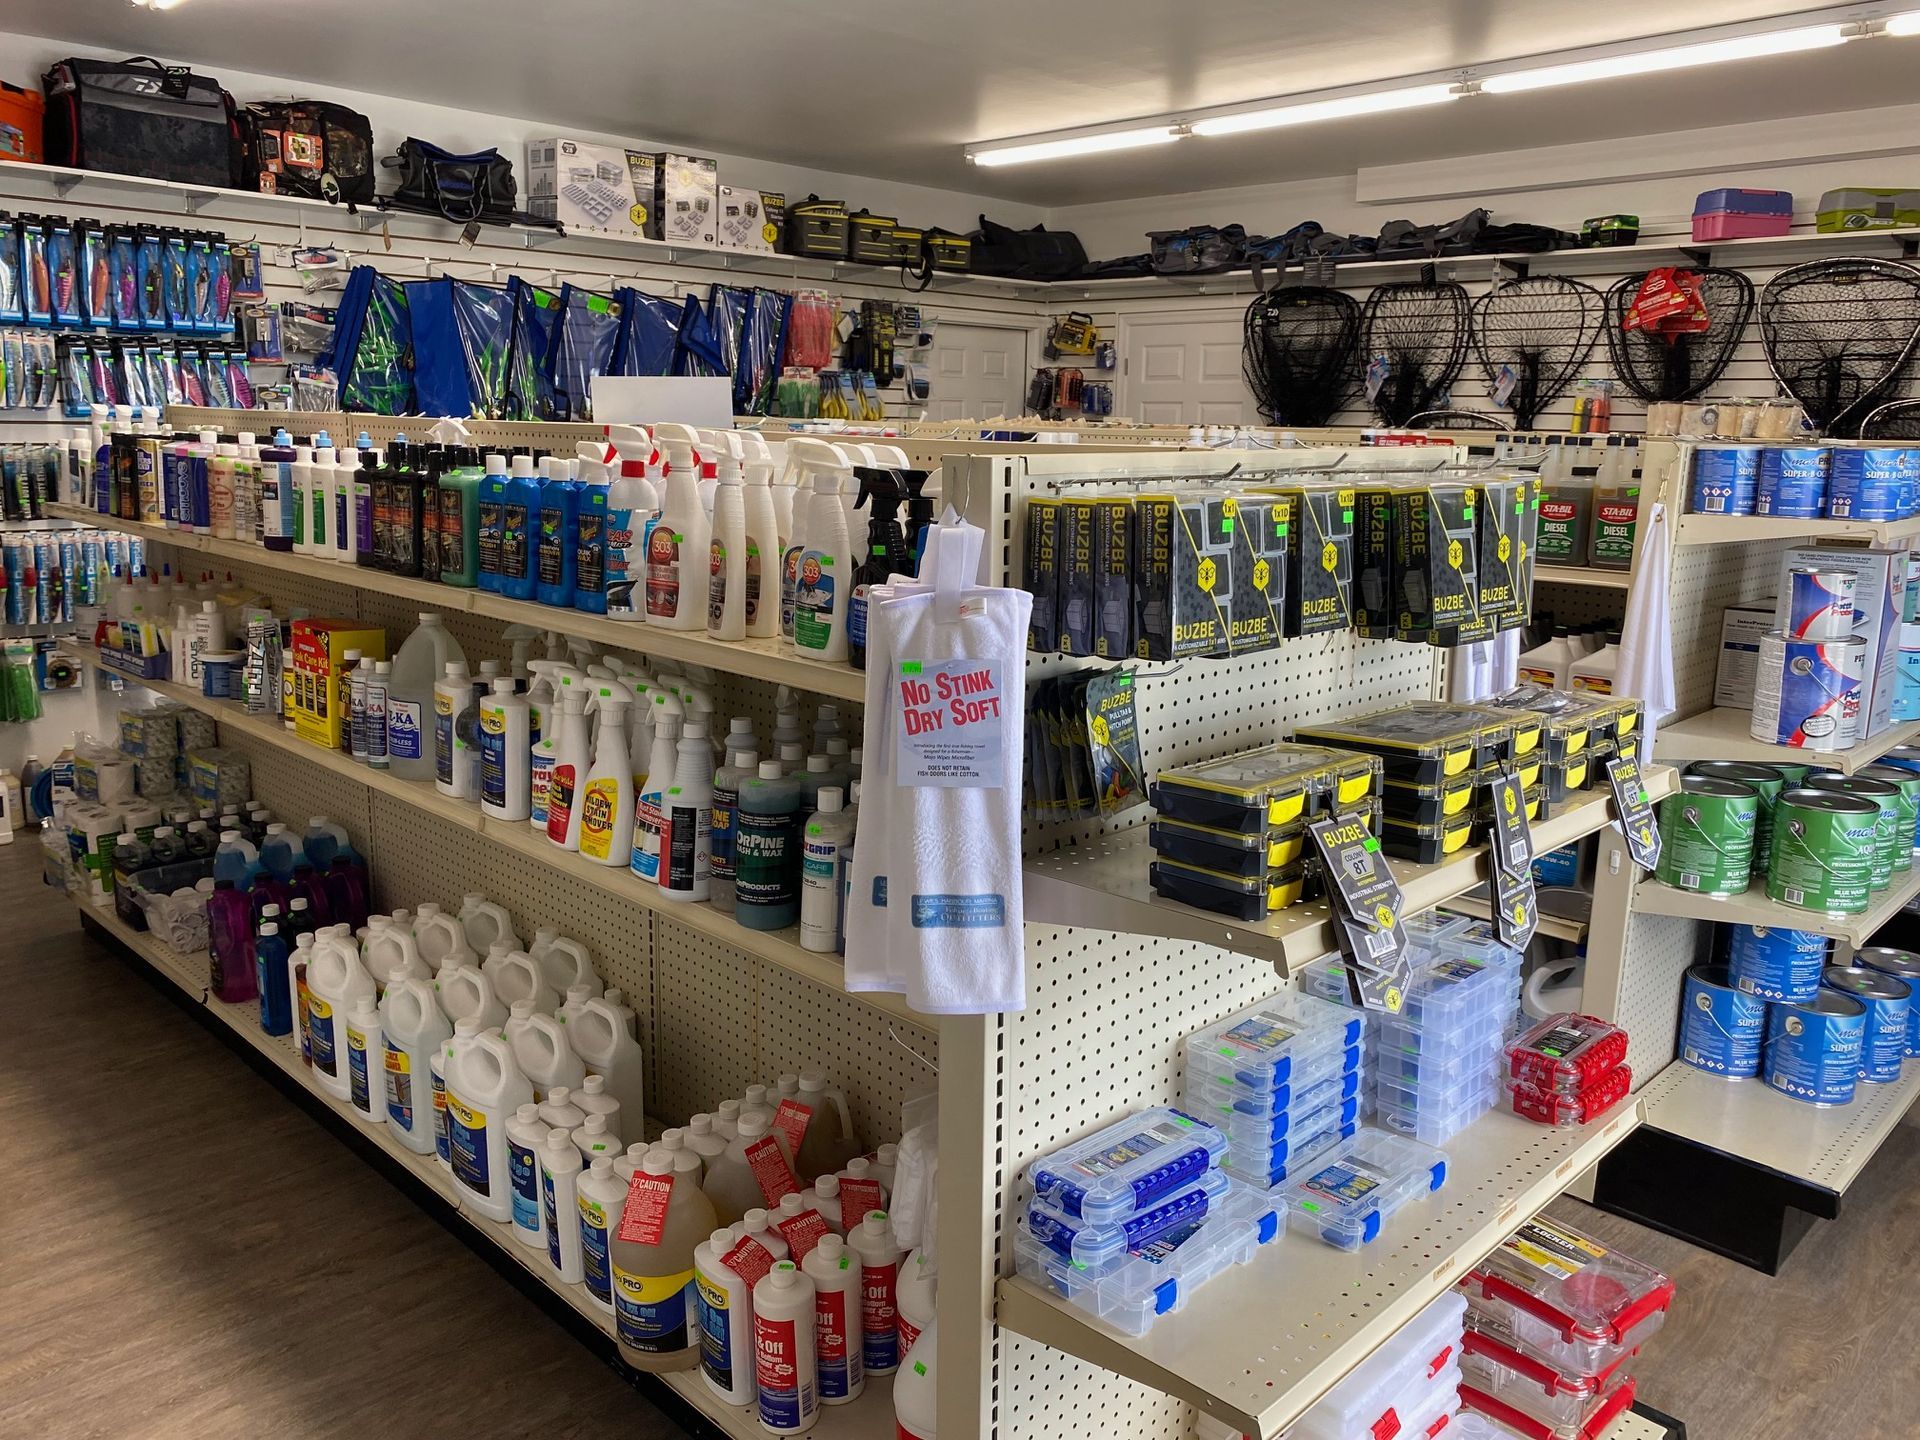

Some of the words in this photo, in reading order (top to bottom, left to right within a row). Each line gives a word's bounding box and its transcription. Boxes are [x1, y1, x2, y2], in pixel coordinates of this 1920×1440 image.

[1224, 503, 1235, 513] 1x1
[1543, 504, 1572, 514] STA-BIL
[1602, 507, 1633, 516] STA-BIL
[1371, 494, 1385, 554] BUZBE
[1410, 494, 1425, 556] BUZBE
[1544, 522, 1568, 533] DIESEL
[1603, 526, 1628, 536] DIESEL
[607, 530, 633, 541] CAS
[1034, 512, 1042, 557] CUSTOMIZABLE
[1040, 507, 1055, 572] BUZBE
[1076, 507, 1091, 573] BUZBE
[1112, 506, 1126, 574] BUZBE
[1153, 504, 1169, 574] BUZBE
[654, 540, 672, 553] 303
[65, 545, 73, 576] Depth
[87, 543, 96, 574] Depth
[133, 542, 142, 573] Depth
[804, 566, 818, 578] 303
[1434, 594, 1464, 612] BUZBE
[1481, 588, 1509, 603] BUZBE
[1303, 597, 1336, 616] BUZBE
[1174, 620, 1215, 642] BUZBE
[1232, 617, 1268, 637] BUZBE
[1178, 640, 1208, 651] CUSTOMIZABLE
[248, 638, 265, 695] FLITZ
[304, 652, 318, 666] Care
[318, 656, 329, 670] Kit
[1100, 690, 1132, 712] BUZBE
[488, 719, 502, 728] PRO
[1110, 710, 1120, 720] PULL
[1614, 764, 1638, 782] BUZBE
[586, 804, 609, 818] STAIN
[1507, 816, 1521, 828] BUZBE
[1323, 824, 1365, 848] BUZBE
[753, 848, 760, 857] &
[762, 849, 783, 857] WAX
[1344, 850, 1364, 862] COLONY
[1352, 860, 1367, 875] 8T
[1349, 888, 1373, 900] INDUSTRIAL
[1373, 880, 1394, 892] STRENGTH
[754, 1142, 779, 1161] CAUTION
[638, 1179, 671, 1193] CAUTION
[588, 1210, 602, 1224] PRO
[791, 1214, 822, 1231] CAUTION
[1533, 1226, 1576, 1251] LOCKER
[734, 1239, 758, 1264] CAUTION
[622, 1278, 642, 1290] PRO
[868, 1286, 887, 1299] Off
[708, 1287, 724, 1304] PRO
[816, 1312, 834, 1326] Off
[758, 1339, 765, 1350] &
[766, 1340, 784, 1355] Off
[760, 1352, 783, 1364] Bottom
